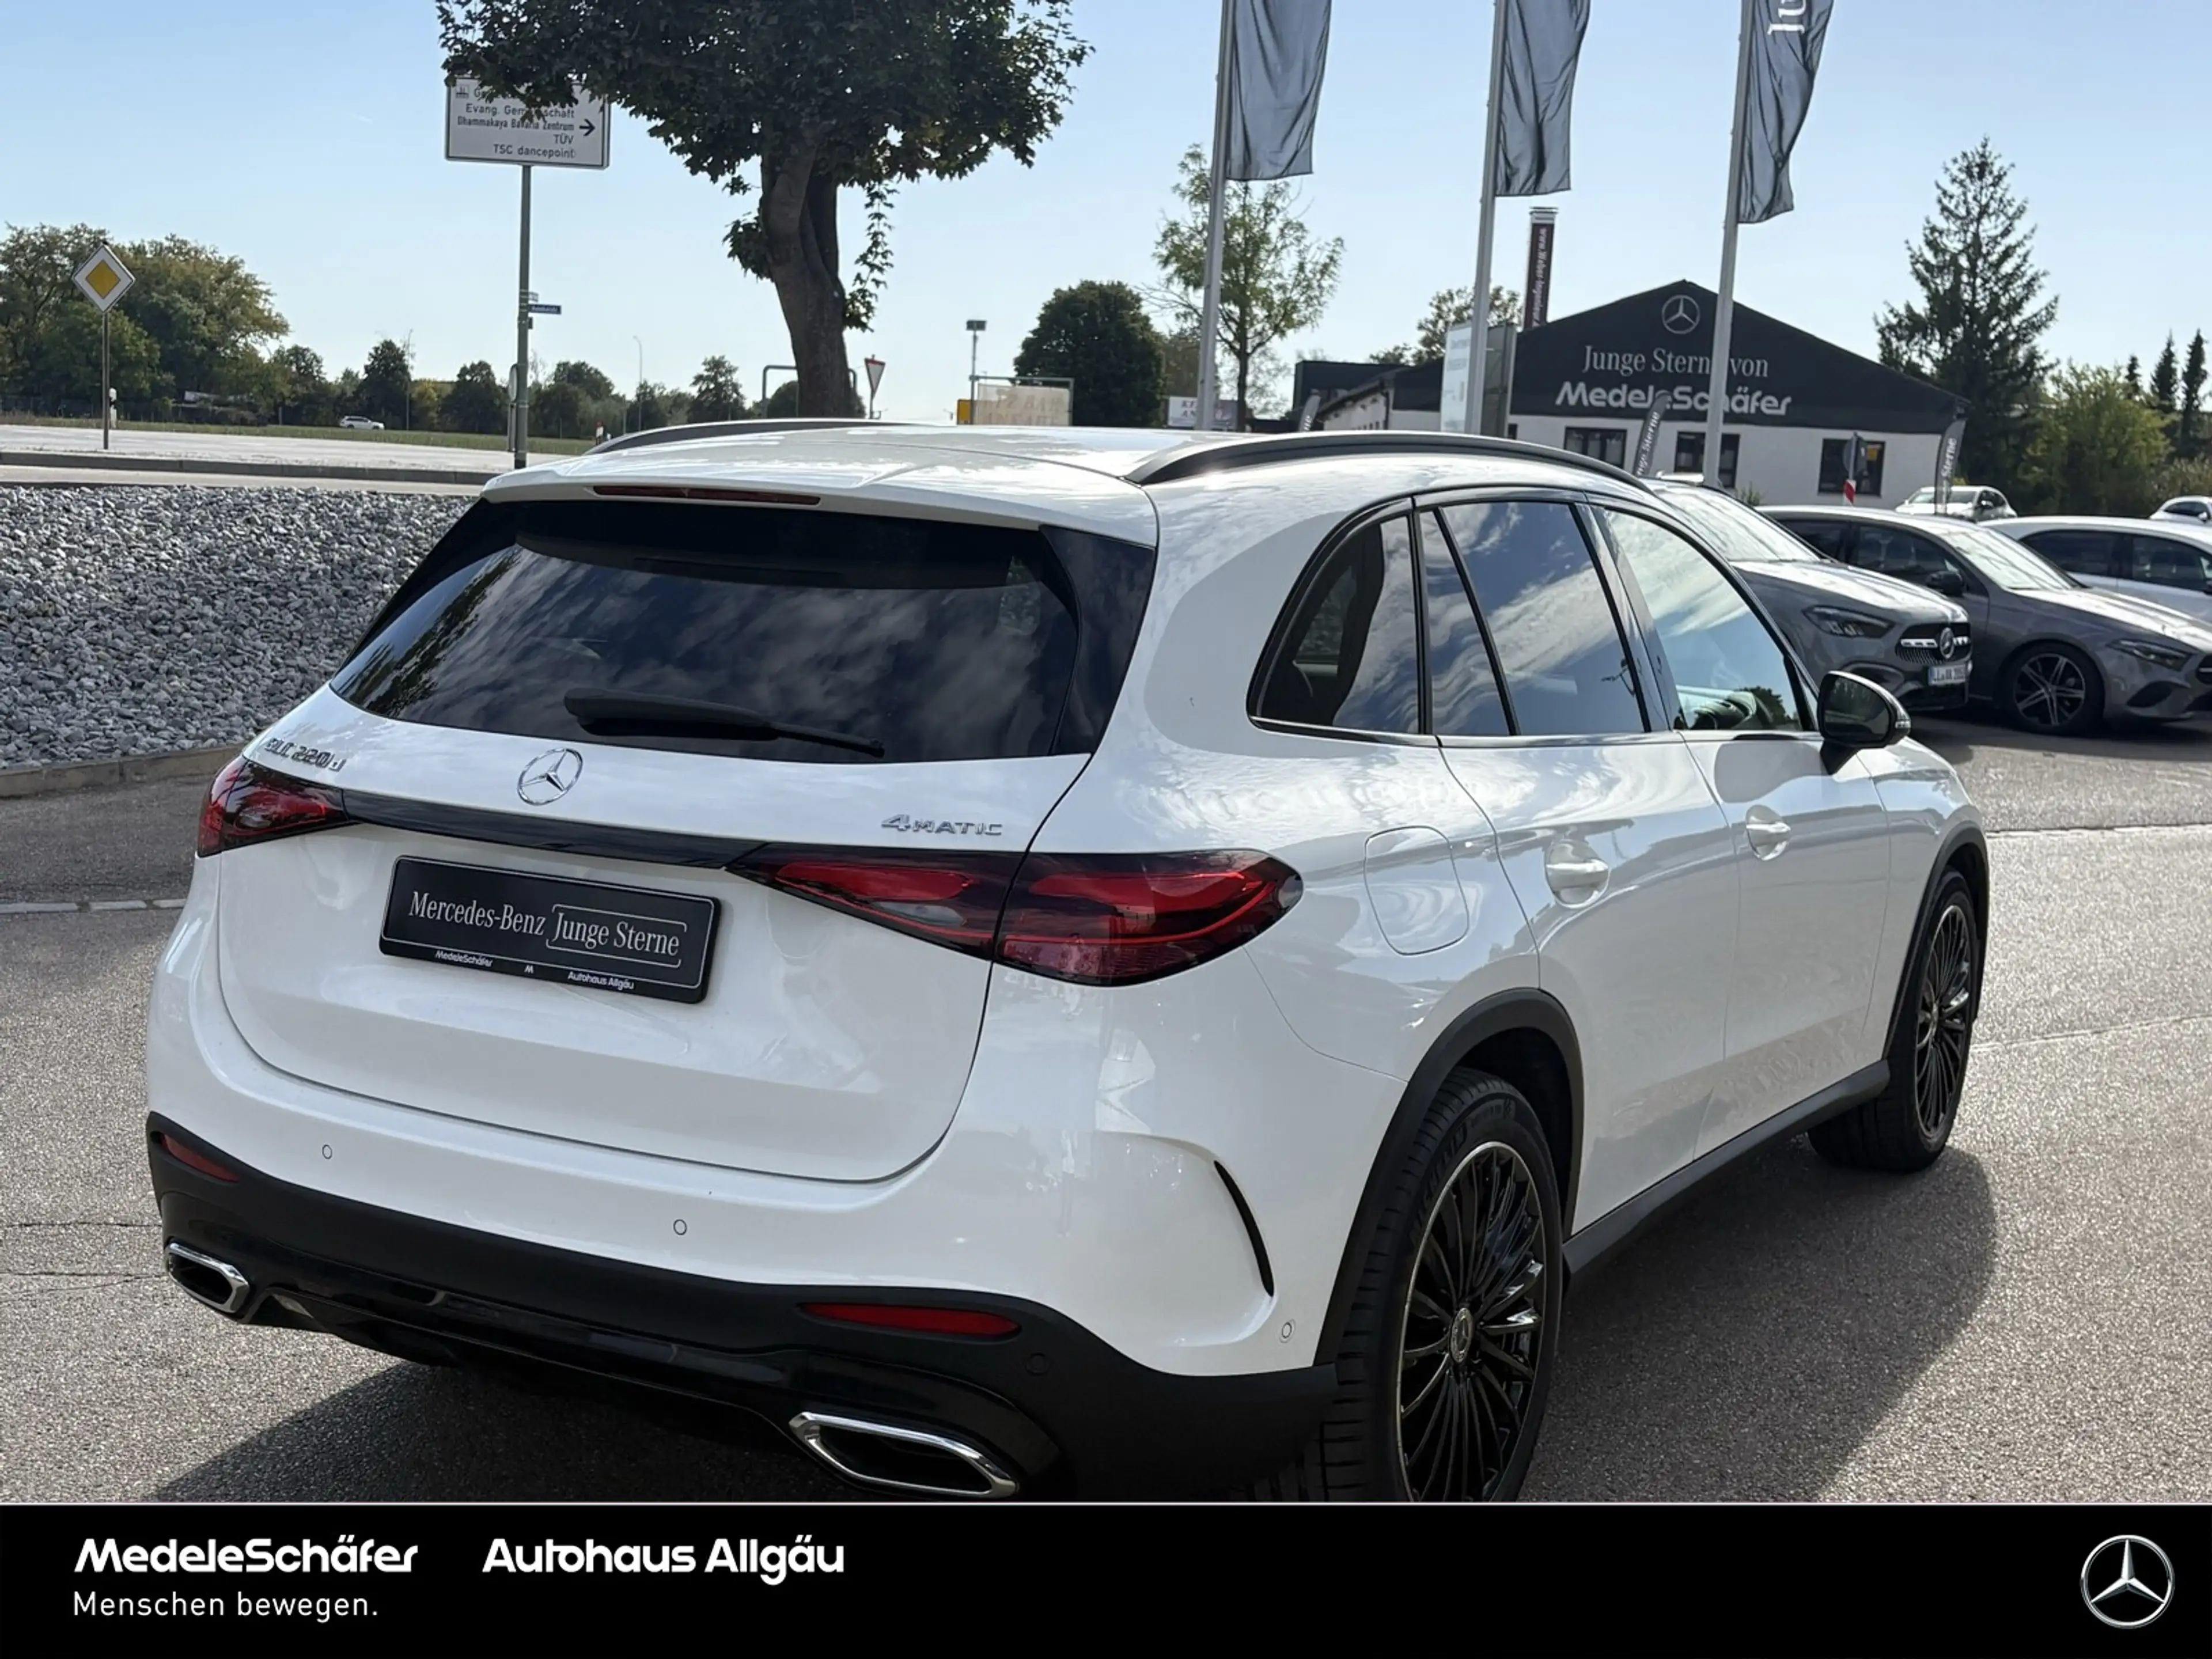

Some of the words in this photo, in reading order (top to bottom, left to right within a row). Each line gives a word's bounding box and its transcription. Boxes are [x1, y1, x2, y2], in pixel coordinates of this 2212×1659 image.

[457, 115, 508, 130] Dhammakaya
[553, 132, 574, 145] TÜV
[493, 143, 513, 155] TSC
[517, 145, 575, 159] dancepoint
[1582, 346, 1646, 377] Junge
[1652, 347, 1712, 374] Stern
[1730, 357, 1769, 377] von
[1556, 380, 1792, 416] MedelScäfer
[1642, 411, 1661, 452] Sterne
[1940, 437, 1957, 478] Sterne
[881, 814, 1003, 836] 4MATIC
[408, 890, 547, 936] Mercedes-Benz
[552, 912, 609, 950] Junge
[612, 922, 680, 956] Sterne
[434, 949, 494, 968] MedeleSchäfer
[567, 970, 608, 986] Autohaus
[607, 976, 635, 991] Allgäu
